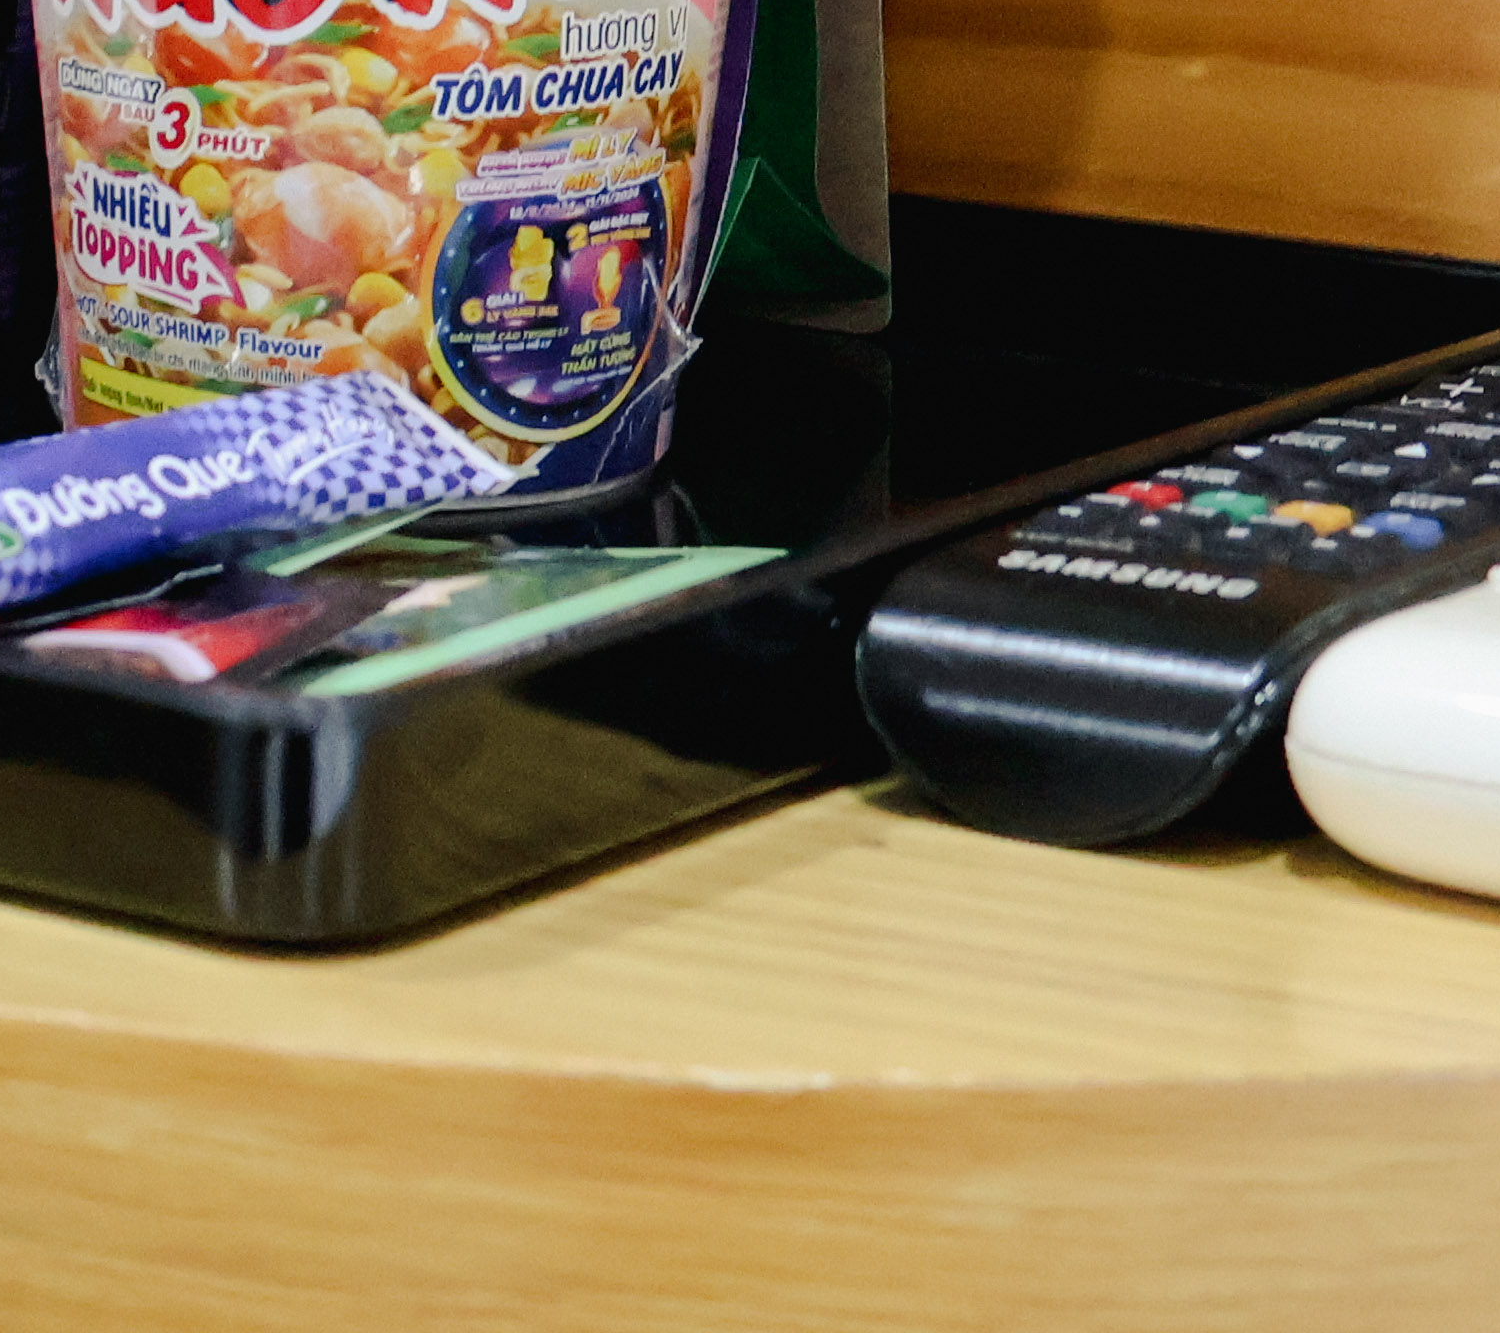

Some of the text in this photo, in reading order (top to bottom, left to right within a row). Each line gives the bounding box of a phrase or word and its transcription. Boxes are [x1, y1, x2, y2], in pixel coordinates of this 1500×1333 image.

[565, 13, 657, 55] hương
[105, 72, 162, 104] NGAY
[435, 50, 683, 116] TÔM CHUA CAY
[156, 101, 191, 150] 3
[196, 126, 267, 156] PHÚT
[93, 177, 171, 239] NHIỀU
[109, 306, 151, 330] SOUR
[155, 315, 227, 348] SHRIMP
[239, 331, 323, 360] Flavour
[147, 449, 254, 500] Que
